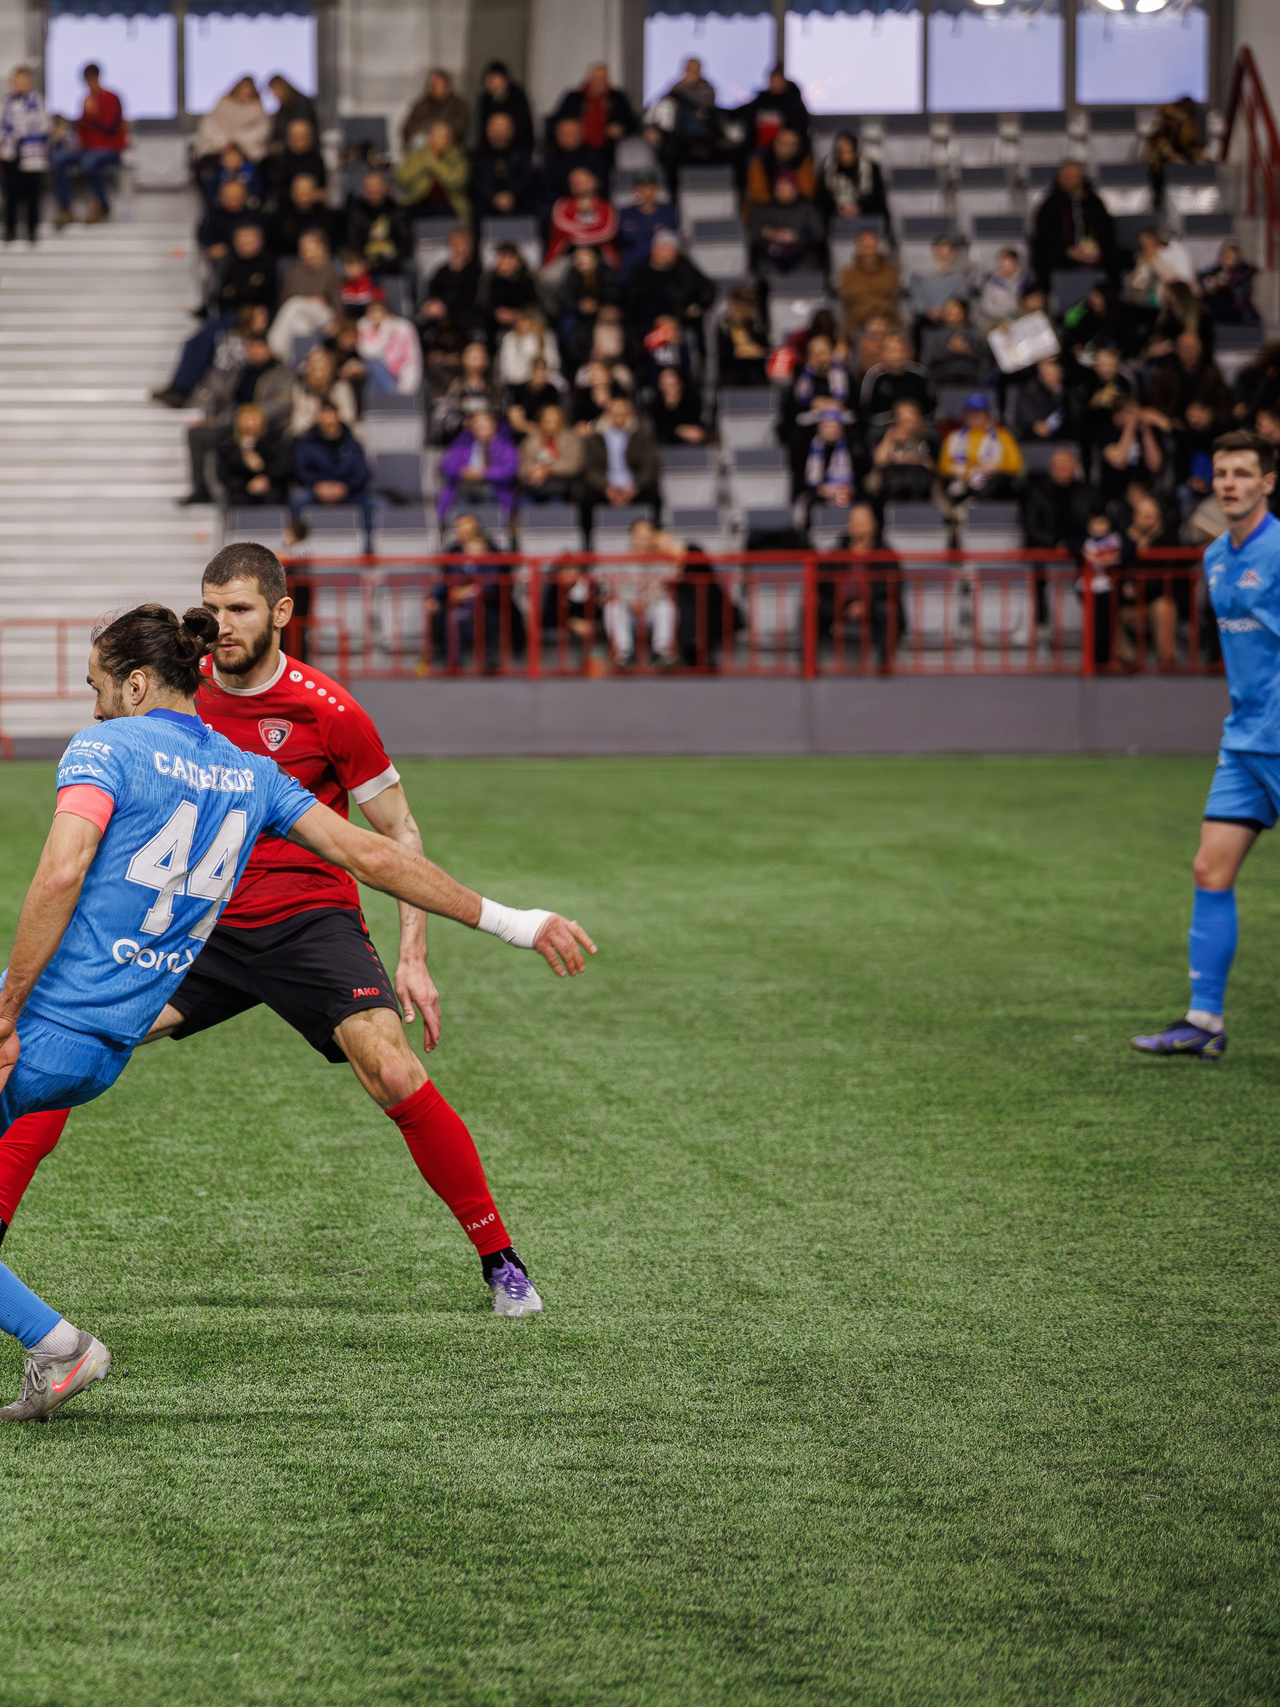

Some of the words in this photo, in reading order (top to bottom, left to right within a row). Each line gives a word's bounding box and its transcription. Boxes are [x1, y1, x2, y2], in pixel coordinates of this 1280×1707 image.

[125, 799, 247, 942] 44
[352, 986, 381, 999] JAKO
[467, 1213, 495, 1231] JAKO
